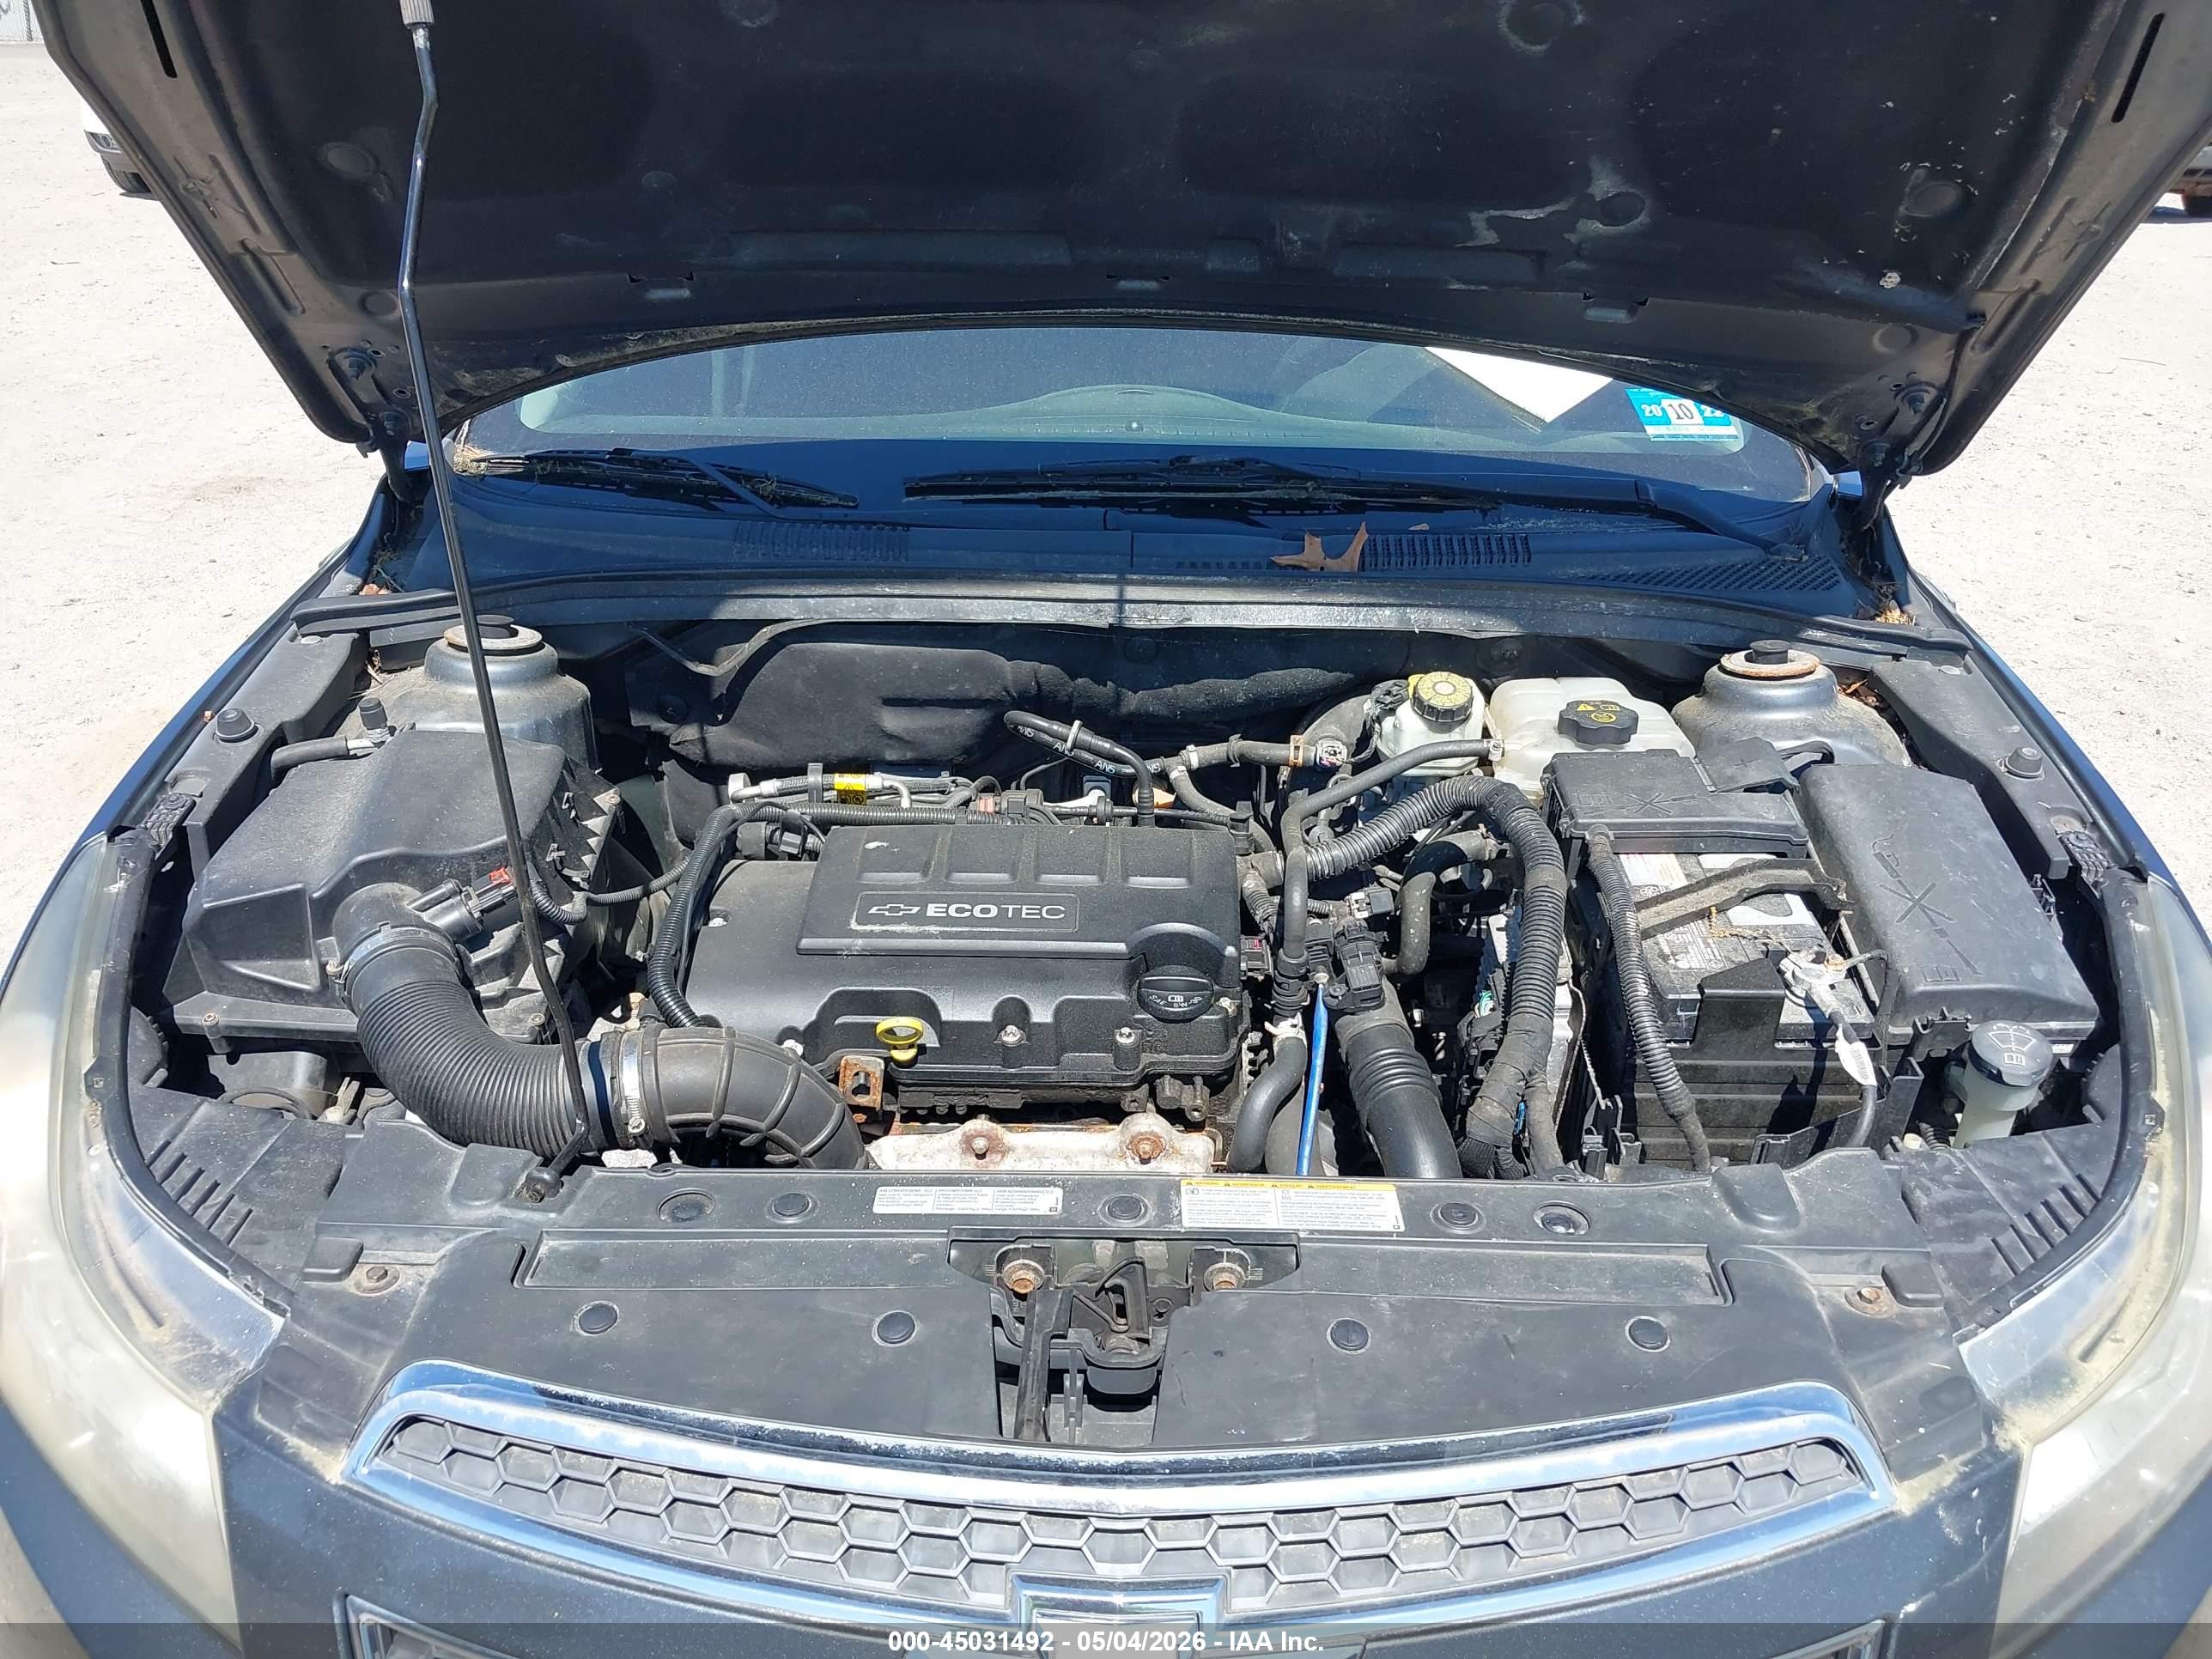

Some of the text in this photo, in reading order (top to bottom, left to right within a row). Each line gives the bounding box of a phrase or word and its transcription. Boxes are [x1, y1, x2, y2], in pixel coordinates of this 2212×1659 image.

[1668, 402, 1693, 420] 10
[1094, 760, 1116, 775] ANS
[926, 902, 1066, 920] ECOTEC
[1148, 994, 1168, 1006] SAE
